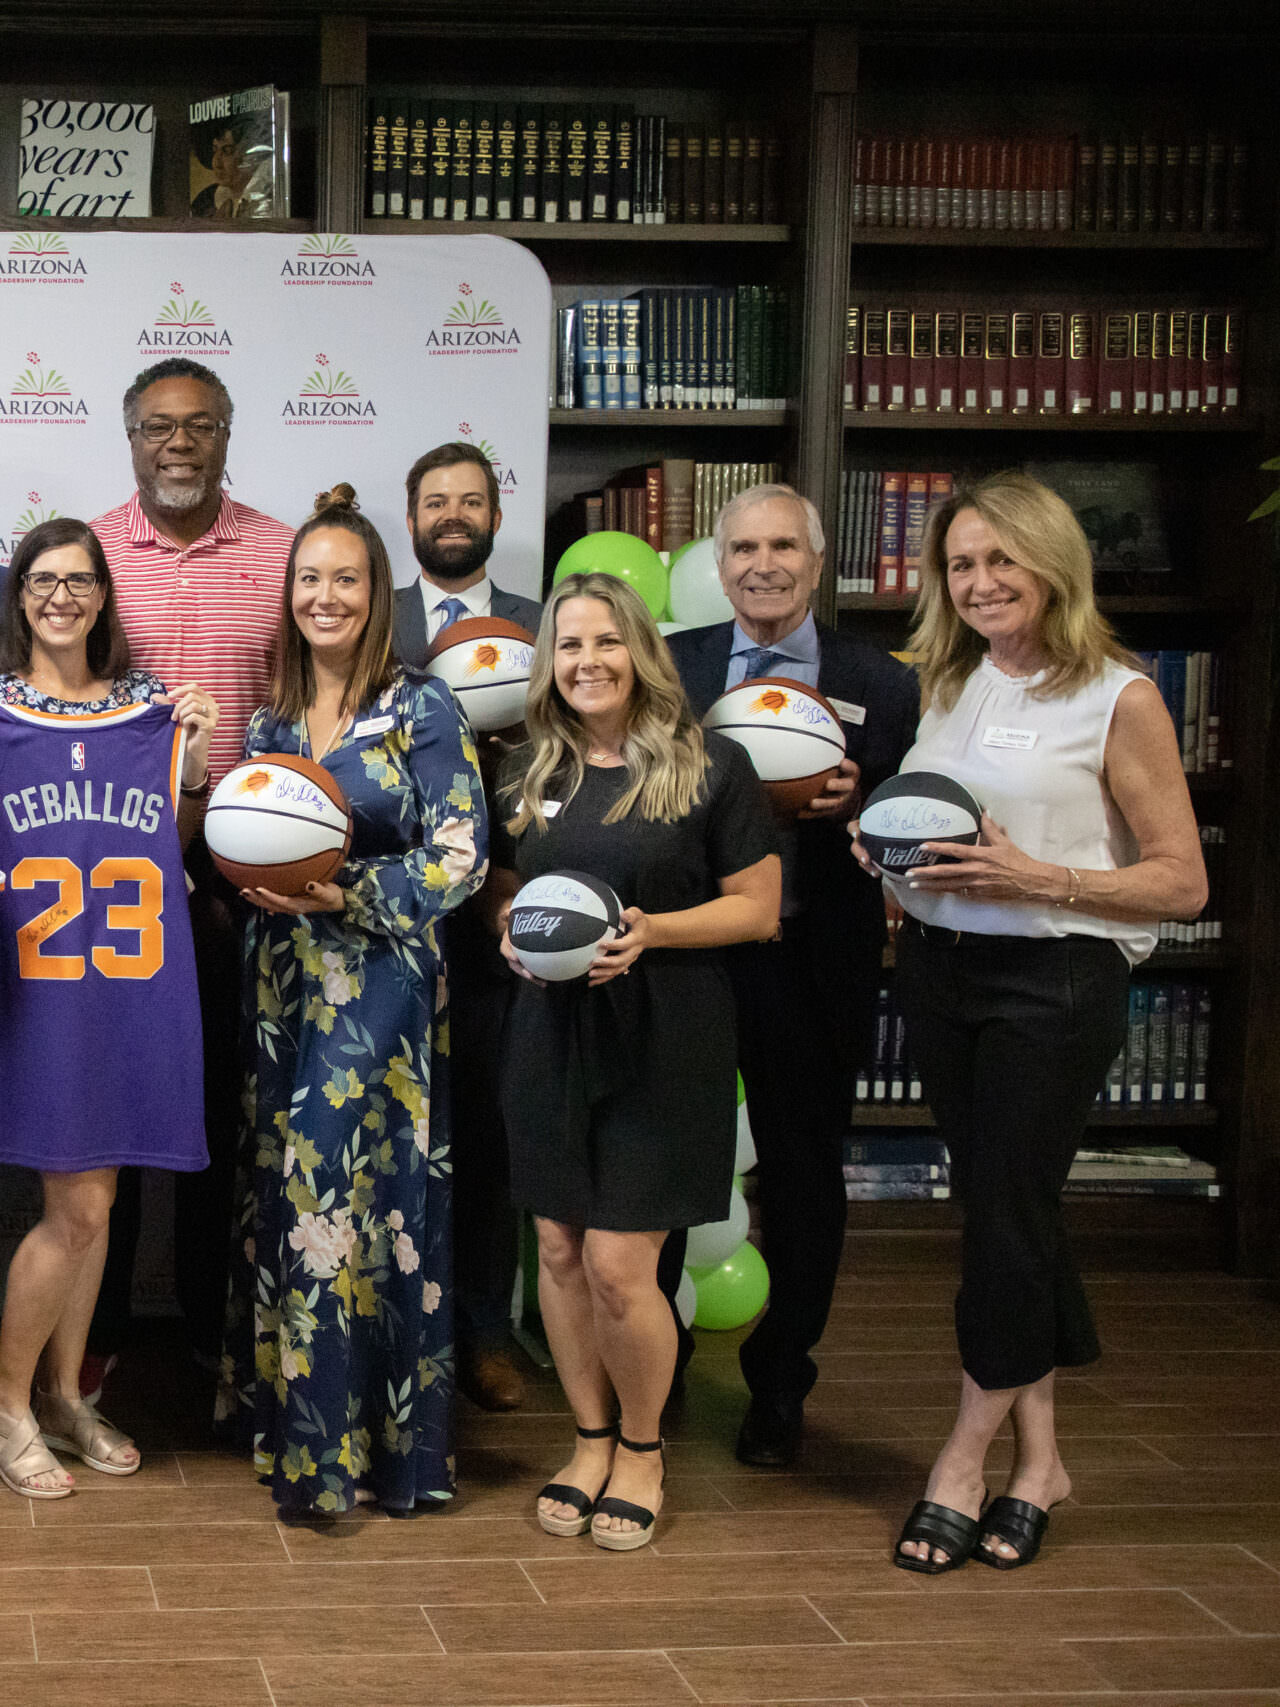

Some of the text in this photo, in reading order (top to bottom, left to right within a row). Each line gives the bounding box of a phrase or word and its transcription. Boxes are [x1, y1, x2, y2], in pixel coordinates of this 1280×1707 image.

[189, 96, 232, 125] LOUVRE
[20, 145, 129, 178] years
[18, 177, 136, 217] of art
[280, 259, 376, 277] ARIZONA
[137, 328, 233, 346] ARIZONA
[425, 327, 521, 347] ARIZONA
[281, 399, 377, 417] ARIZONA
[2, 780, 164, 834] CEBALLOS
[10, 857, 164, 980] 23
[512, 910, 562, 937] Valley
